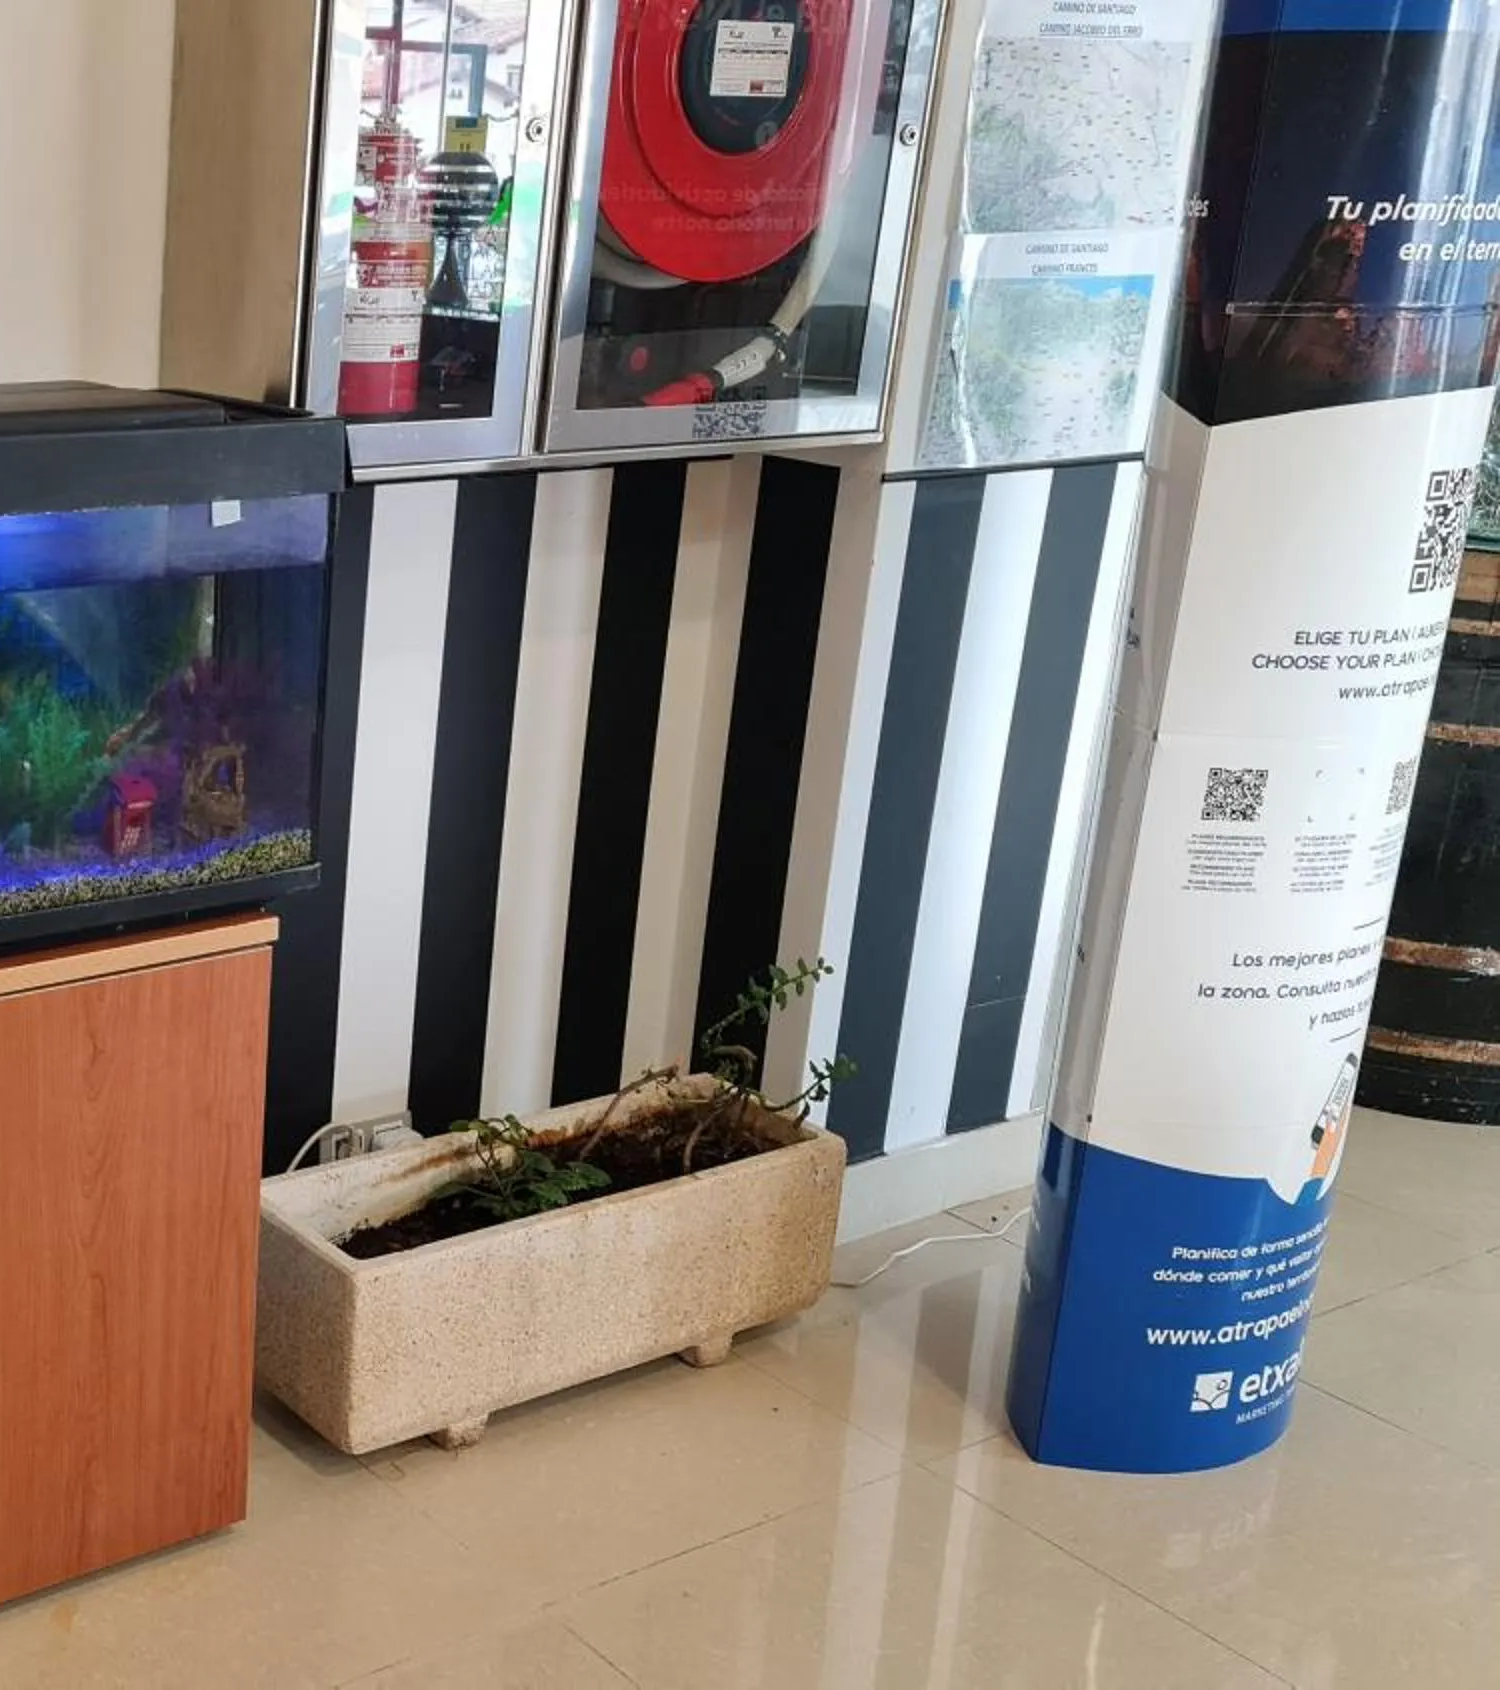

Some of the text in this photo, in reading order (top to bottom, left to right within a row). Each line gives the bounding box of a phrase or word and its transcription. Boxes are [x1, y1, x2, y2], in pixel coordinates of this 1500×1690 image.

[1053, 2, 1137, 15] CAMINO DE SANTIAGO
[1040, 23, 1071, 35] CAMINO
[1327, 194, 1500, 227] Tu planificad
[1026, 243, 1057, 255] CAMINO
[1072, 242, 1109, 253] SANTIAGO
[1399, 243, 1432, 261] en
[1440, 236, 1464, 261] el
[1032, 263, 1064, 276] CAMINO
[1294, 631, 1342, 646] ELIGE
[1349, 630, 1371, 645] TU
[1373, 627, 1410, 644] PLAN
[1252, 653, 1331, 670] CHOOSE
[1336, 654, 1381, 669] YOUR
[1384, 651, 1416, 668] PLAN
[1232, 953, 1264, 968] Los
[1269, 952, 1334, 971] mejores
[1197, 983, 1216, 998] la
[1221, 985, 1271, 999] zona.
[1277, 980, 1341, 999] Consulta
[1309, 1015, 1318, 1031] y
[1171, 1247, 1238, 1261] Planifica
[1241, 1245, 1259, 1259] de
[1261, 1237, 1296, 1255] forma
[1153, 1268, 1204, 1283] dónde
[1208, 1268, 1253, 1283] comer
[1255, 1266, 1265, 1281] y
[1266, 1258, 1288, 1277] qué
[1241, 1282, 1285, 1302] nuestro
[1239, 1336, 1306, 1404] etxa
